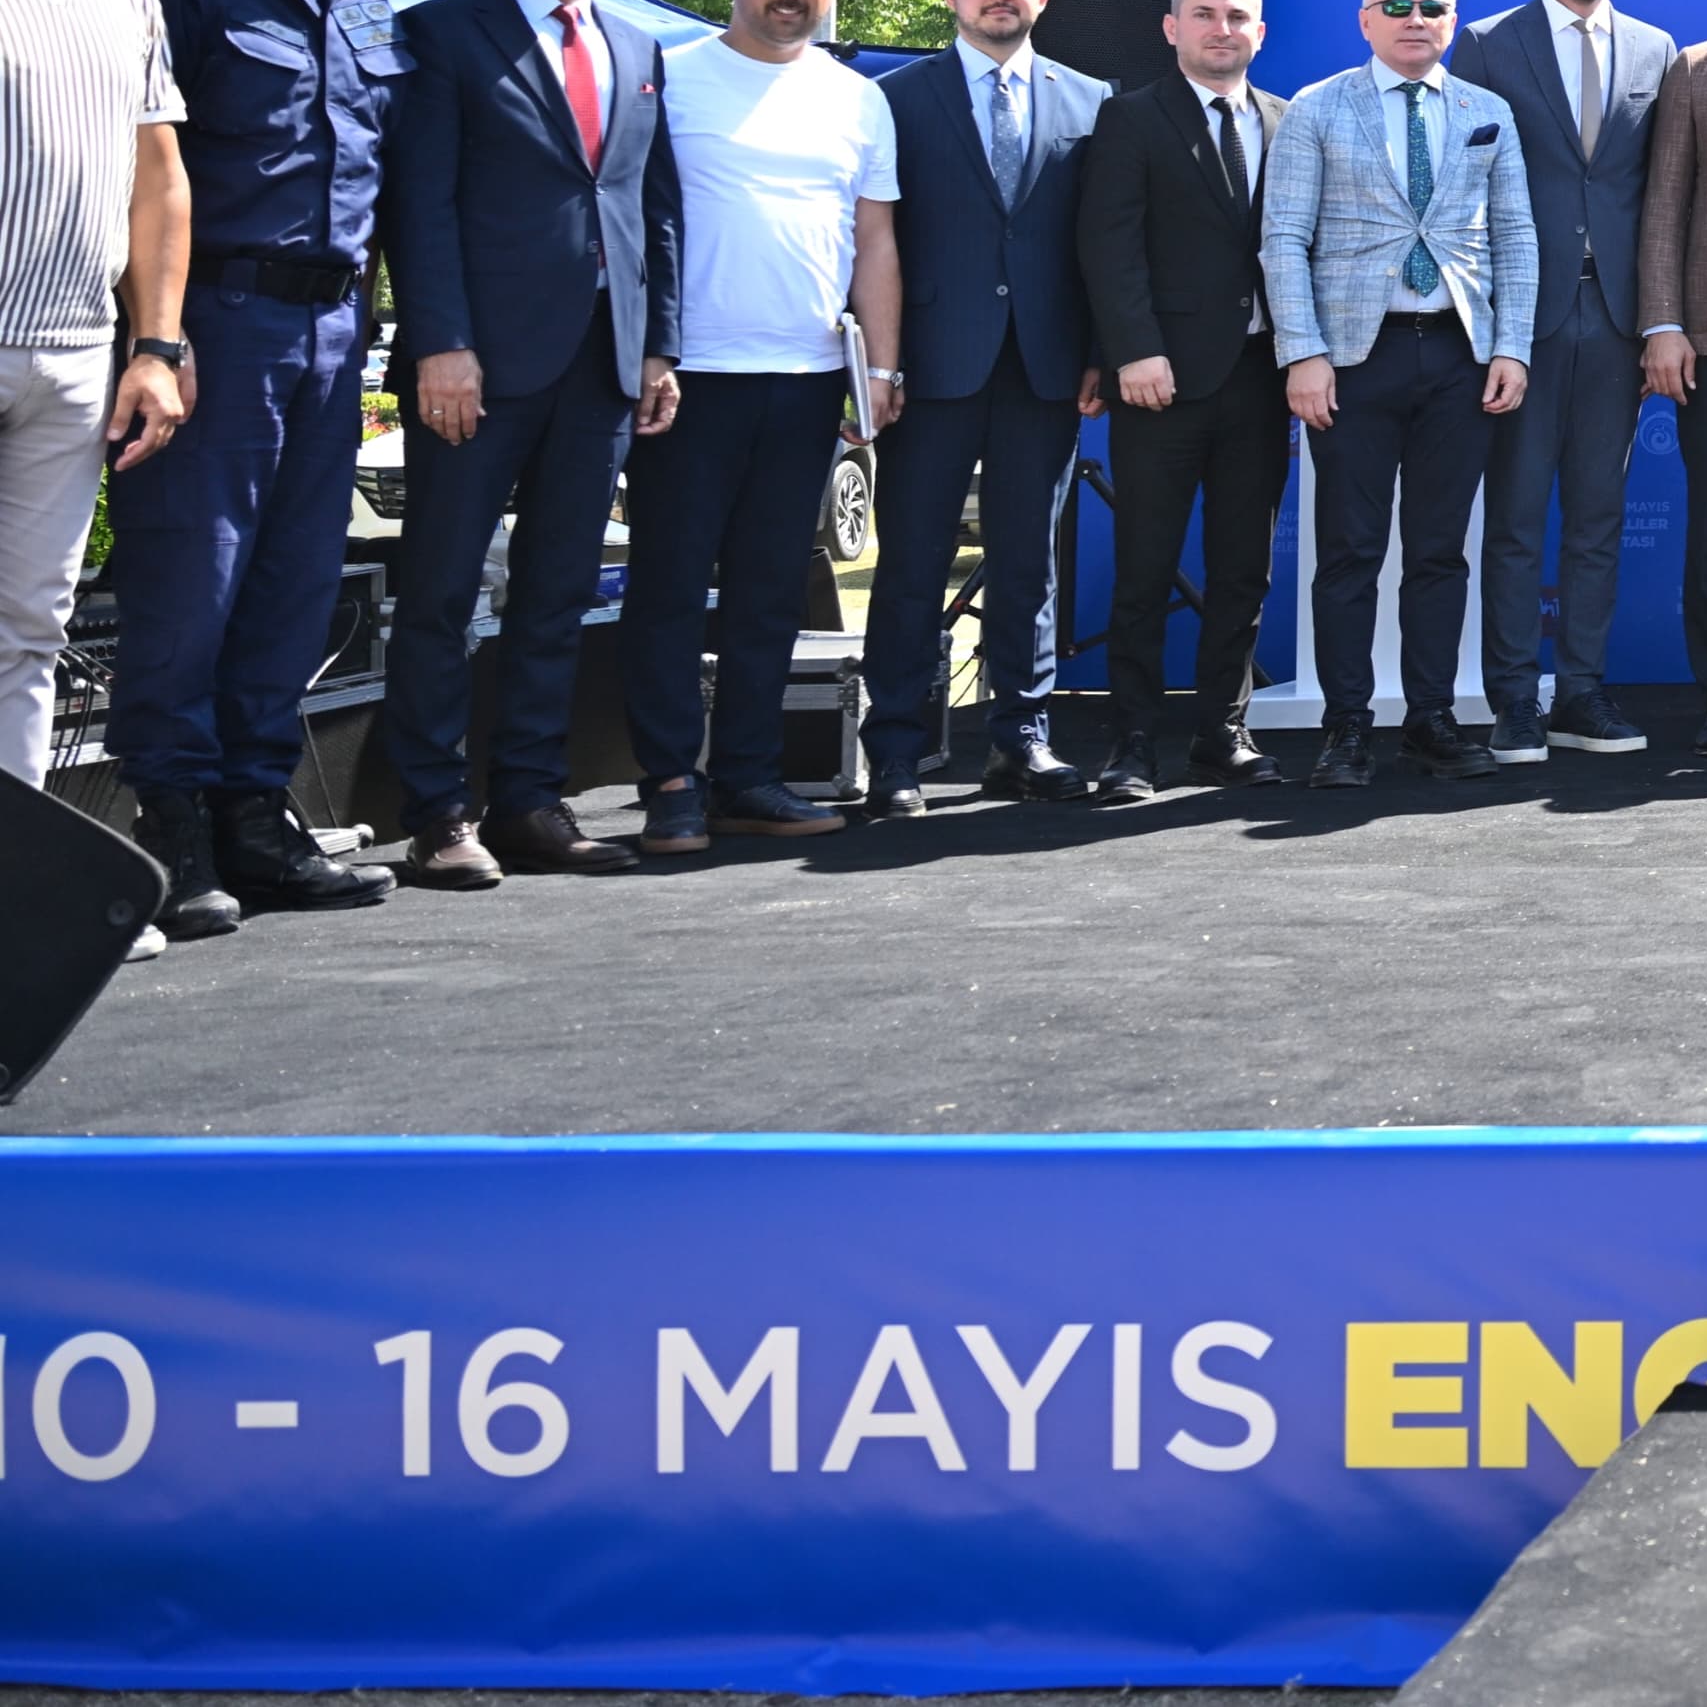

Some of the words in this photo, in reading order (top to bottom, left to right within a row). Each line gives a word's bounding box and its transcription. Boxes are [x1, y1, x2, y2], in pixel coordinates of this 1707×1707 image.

[0, 1330, 156, 1481] 0
[373, 1327, 570, 1478] 16
[656, 1320, 1278, 1474] MAYIS
